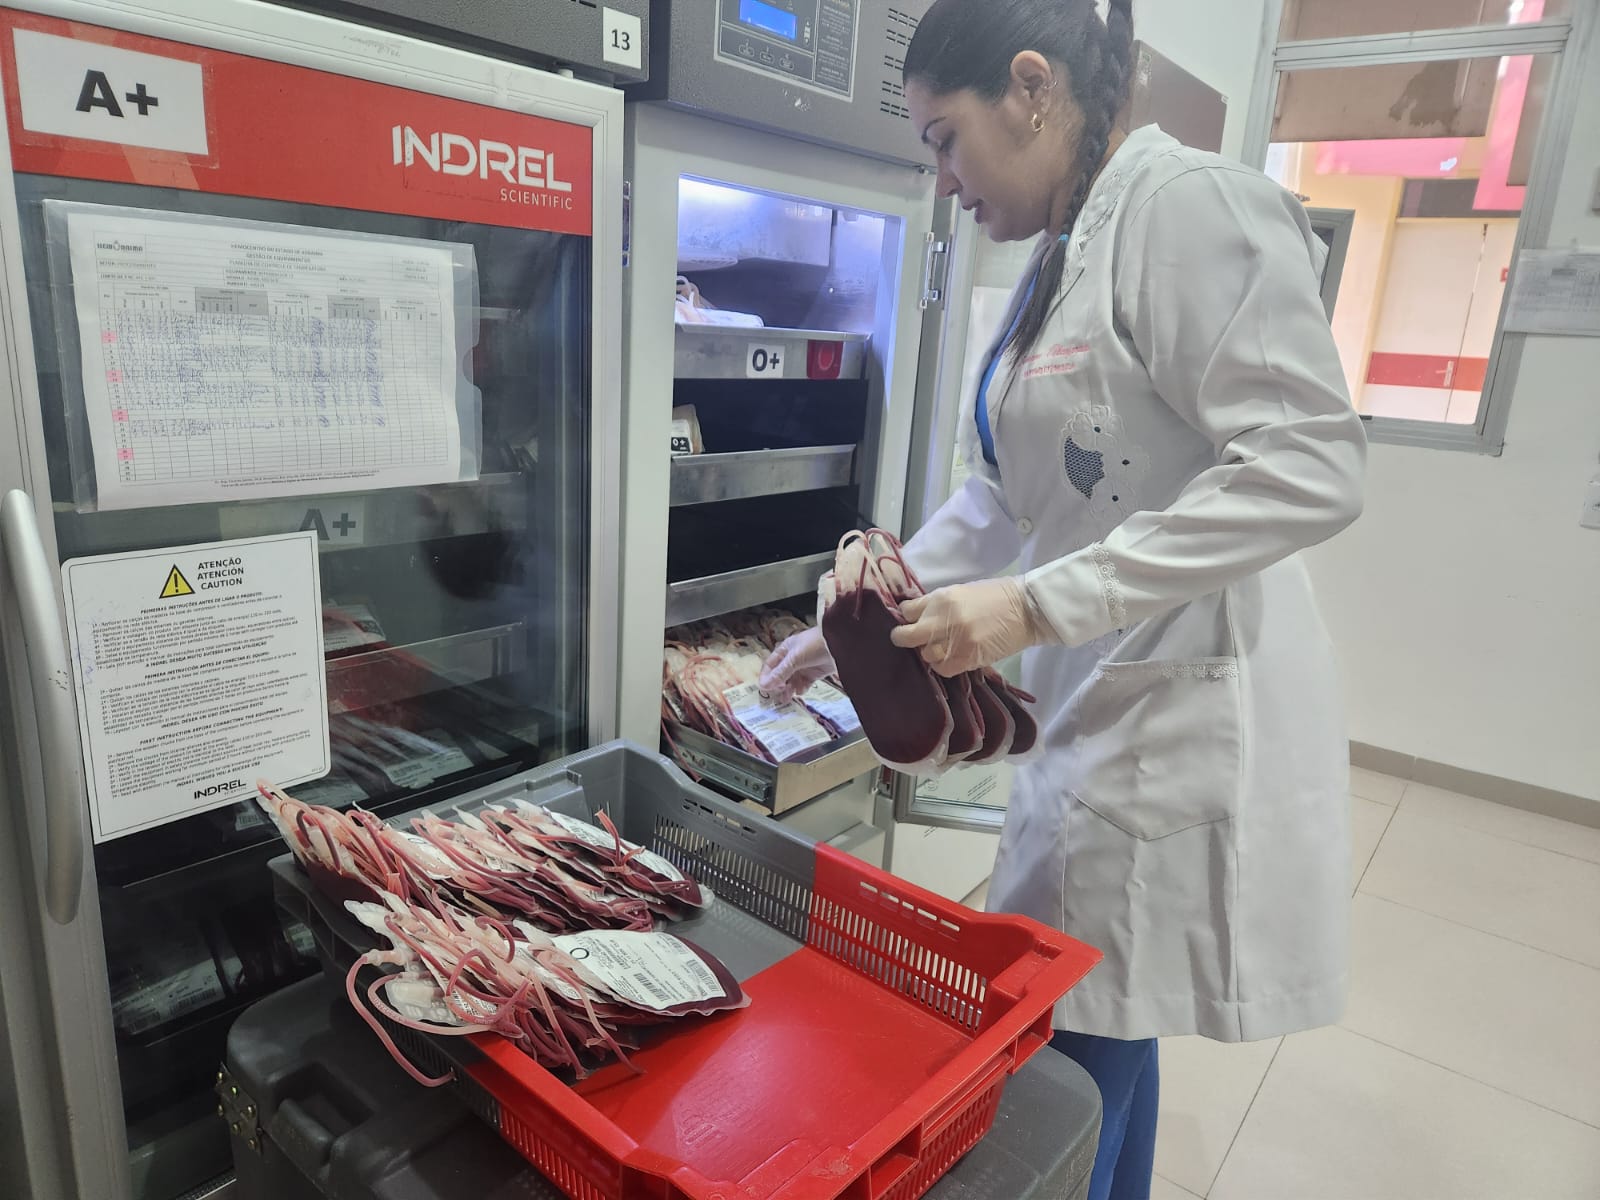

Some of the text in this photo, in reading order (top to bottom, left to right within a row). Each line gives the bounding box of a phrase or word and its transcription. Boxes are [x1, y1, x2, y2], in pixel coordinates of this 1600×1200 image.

[611, 28, 631, 51] 13
[75, 69, 159, 118] A+
[392, 125, 572, 192] INDREL
[500, 188, 573, 210] SCIENTIFIC
[300, 508, 356, 540] A+
[197, 557, 242, 570] ATENÇÃO
[197, 566, 244, 580] ATENCIÓN
[200, 577, 243, 590] CAUTION
[193, 779, 247, 799] INDREL
